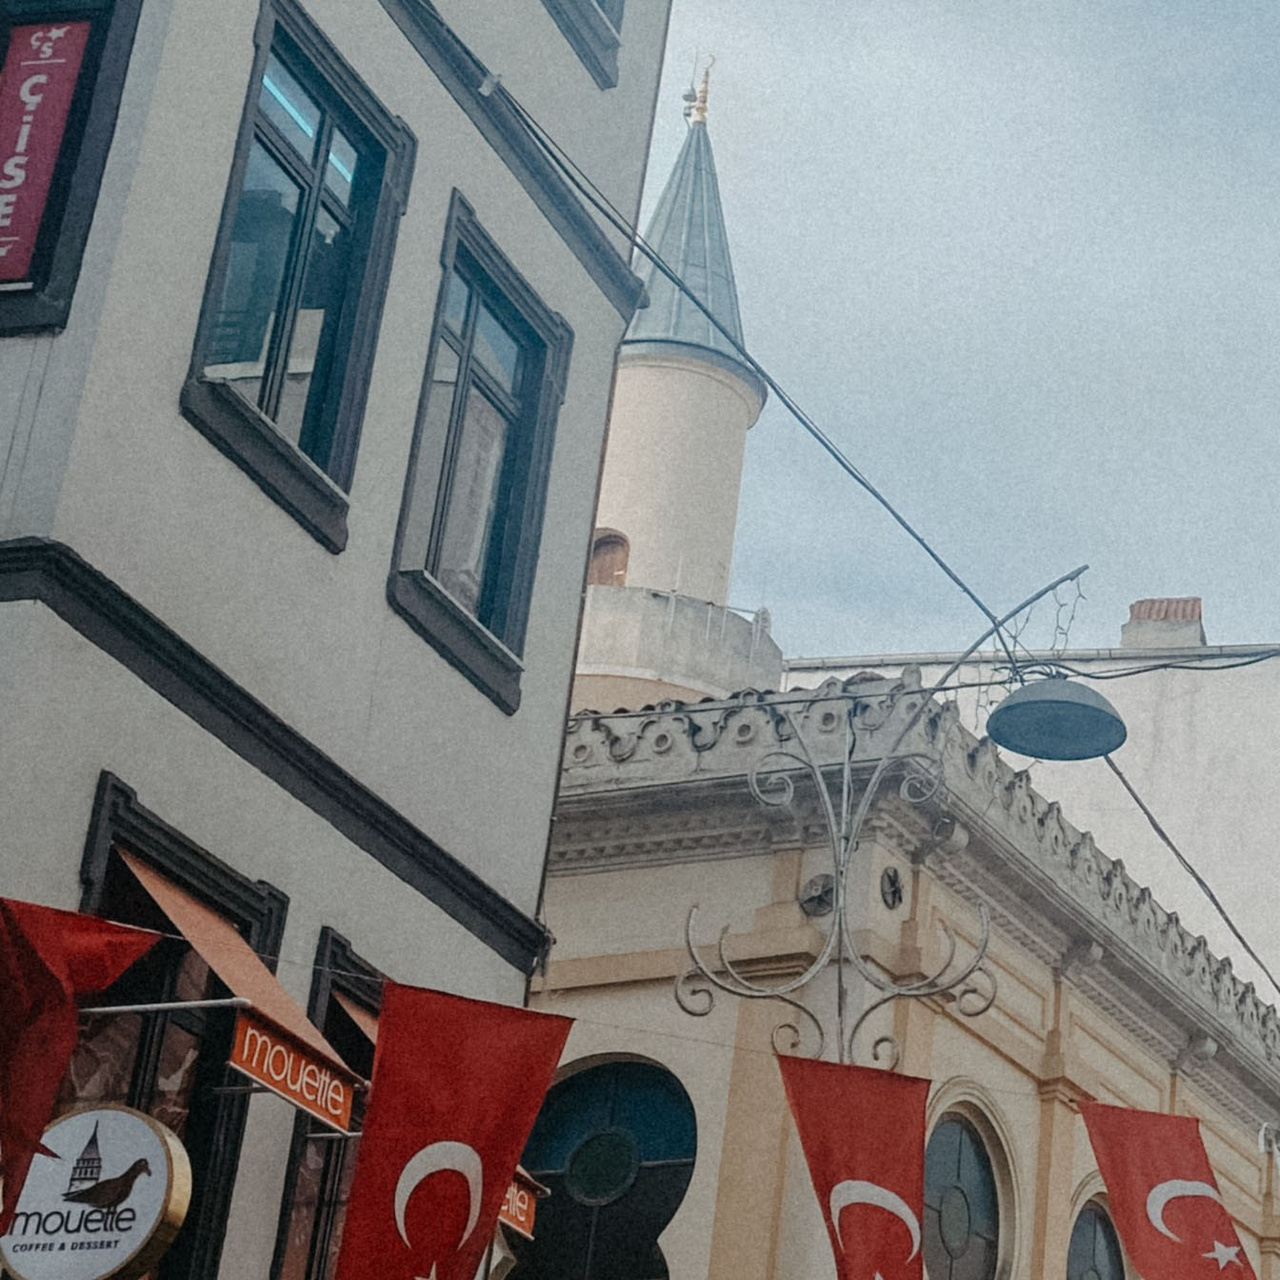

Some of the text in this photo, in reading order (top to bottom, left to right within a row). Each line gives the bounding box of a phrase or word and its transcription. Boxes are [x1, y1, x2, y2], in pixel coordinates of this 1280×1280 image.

[242, 1026, 344, 1115] mouette
[9, 1207, 136, 1236] mouette
[12, 1241, 54, 1253] COFFEE
[70, 1239, 120, 1251] DESSERT
